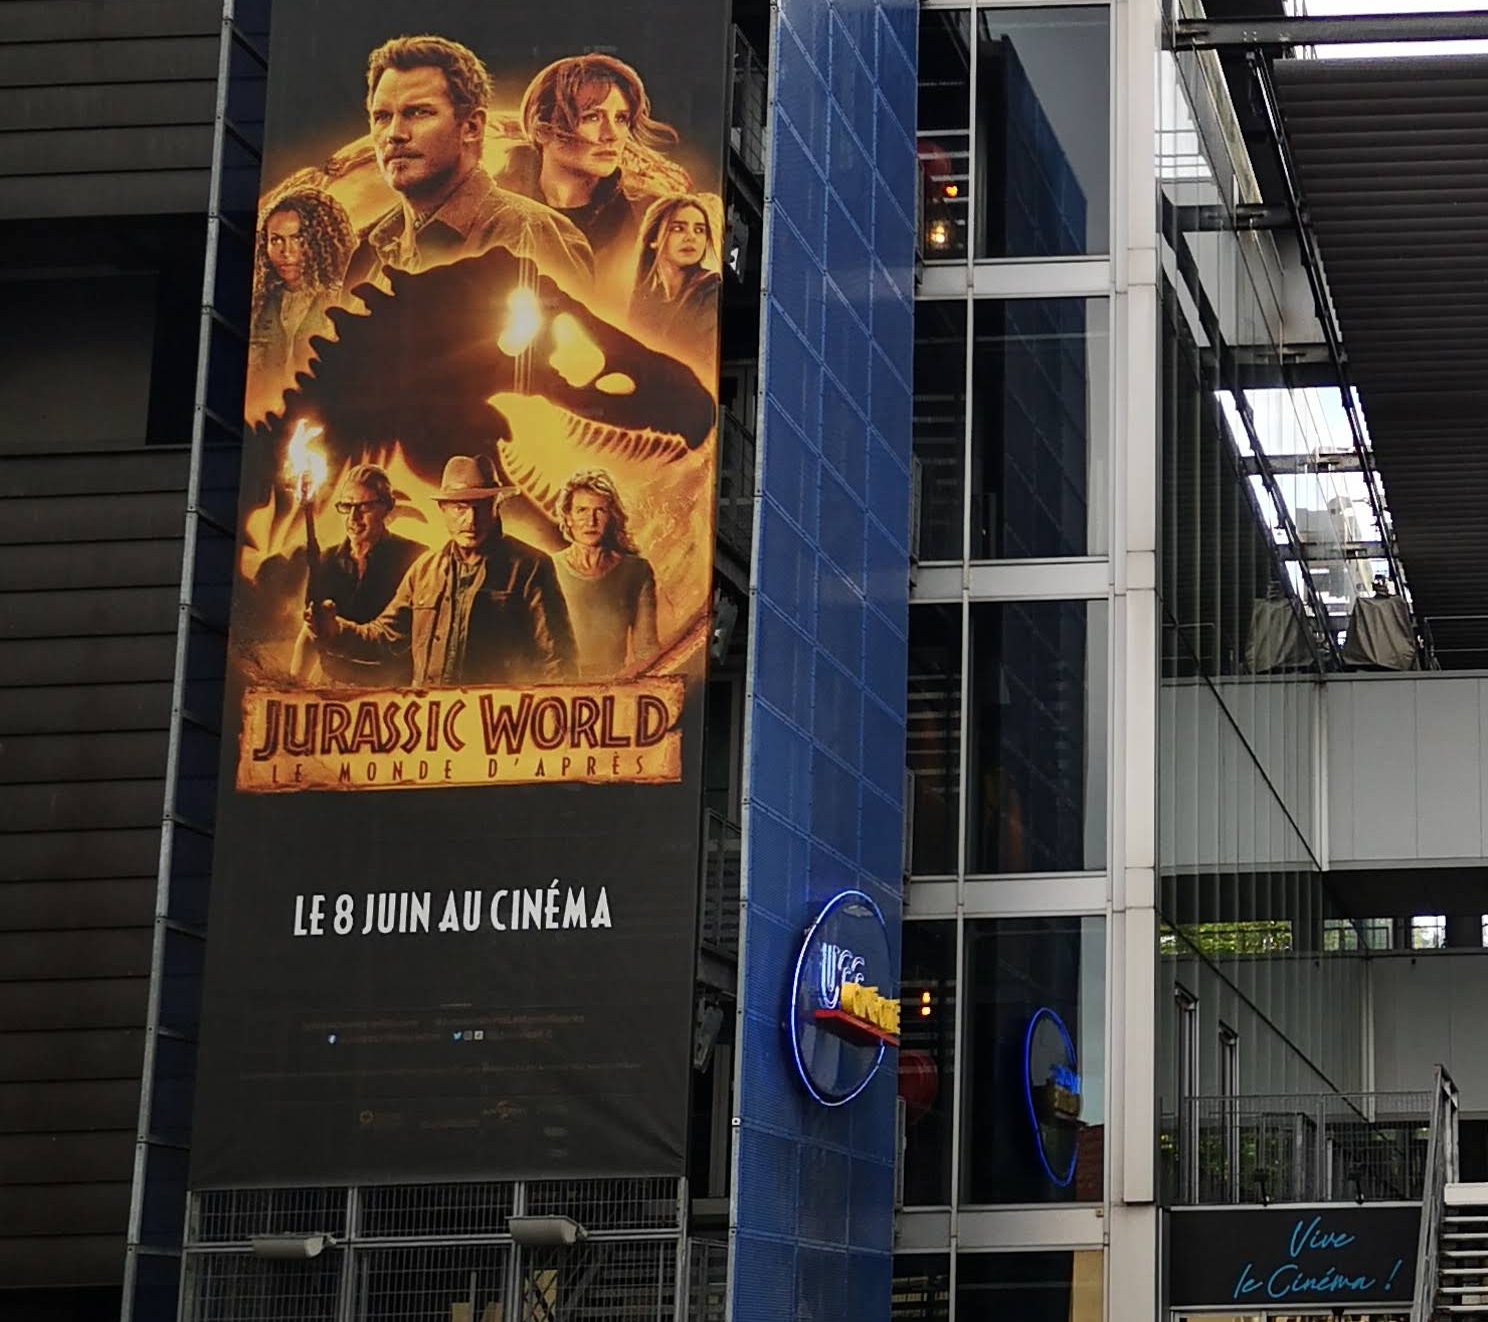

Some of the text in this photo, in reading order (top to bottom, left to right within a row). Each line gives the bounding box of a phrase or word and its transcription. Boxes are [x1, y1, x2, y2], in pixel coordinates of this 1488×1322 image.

[252, 693, 669, 761] JURASSIC WORLD
[272, 751, 643, 783] LE MONDE D'APRÈS
[293, 878, 612, 936] LE 8 JUIN AU CINÉMA
[1290, 1216, 1356, 1257] Vive
[1234, 1263, 1263, 1299] le
[1267, 1264, 1376, 1298] Cinéma
